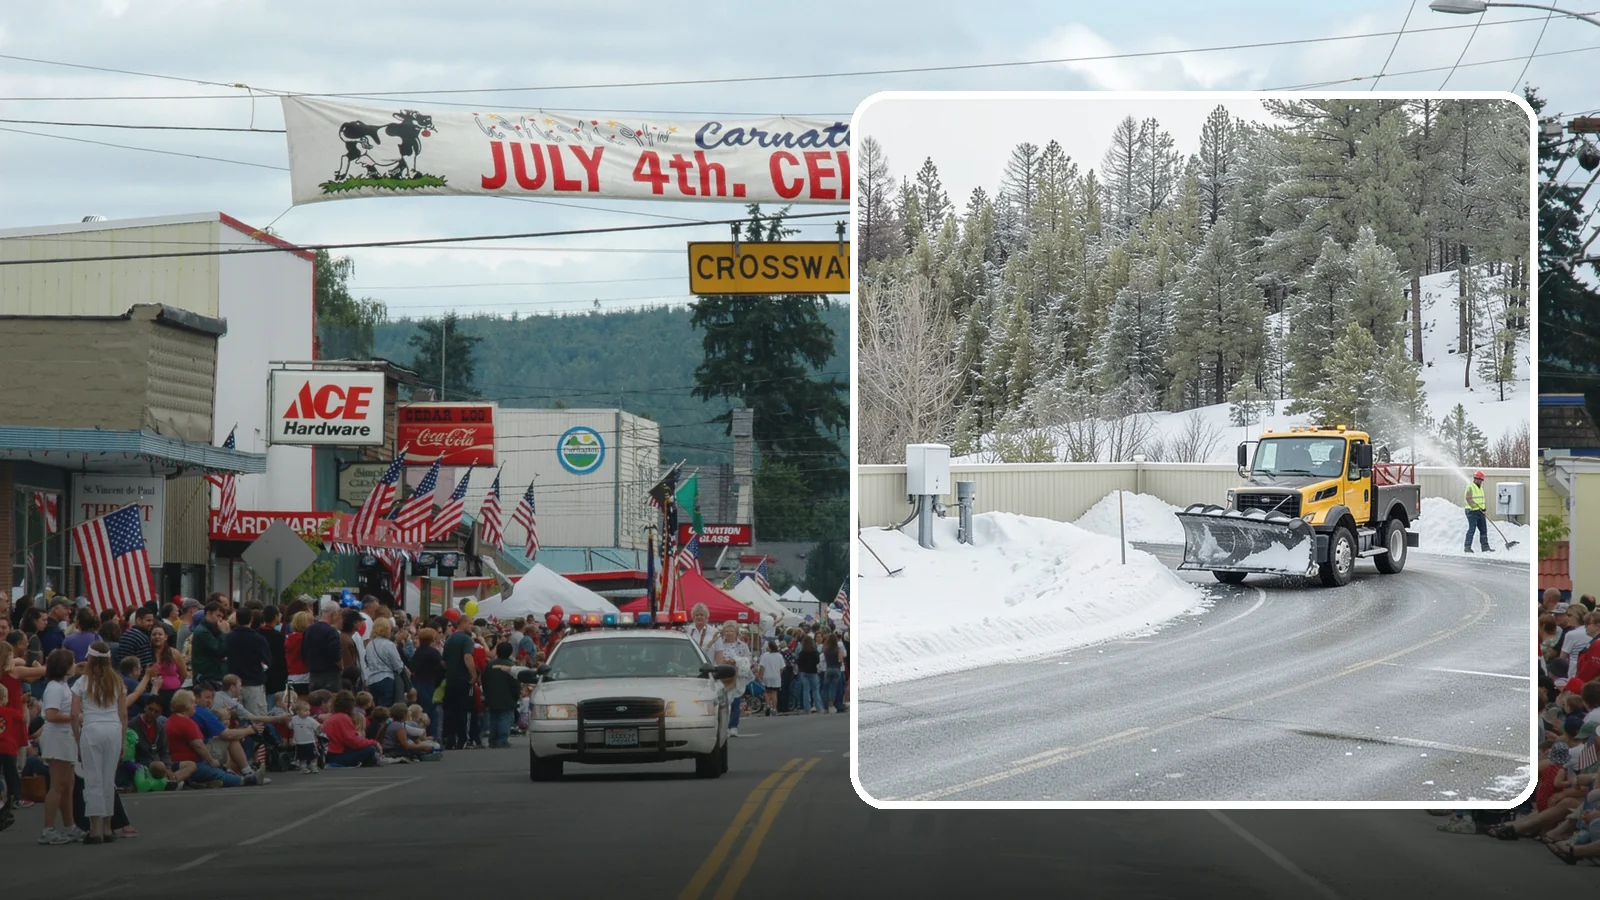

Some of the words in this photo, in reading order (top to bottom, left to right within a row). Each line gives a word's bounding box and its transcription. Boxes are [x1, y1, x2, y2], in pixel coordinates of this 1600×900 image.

[481, 141, 605, 192] JULY
[632, 150, 746, 198] 4th.
[697, 254, 850, 280] CROSSWA
[283, 380, 374, 420] ACE
[405, 409, 452, 422] CEDAR
[283, 421, 371, 437] Hardware
[416, 428, 477, 447] Coca-Cola
[96, 485, 124, 495] Vincent
[126, 486, 136, 495] de
[137, 486, 155, 495] Paul
[688, 526, 742, 535] CRNATION
[699, 535, 731, 544] GLASS
